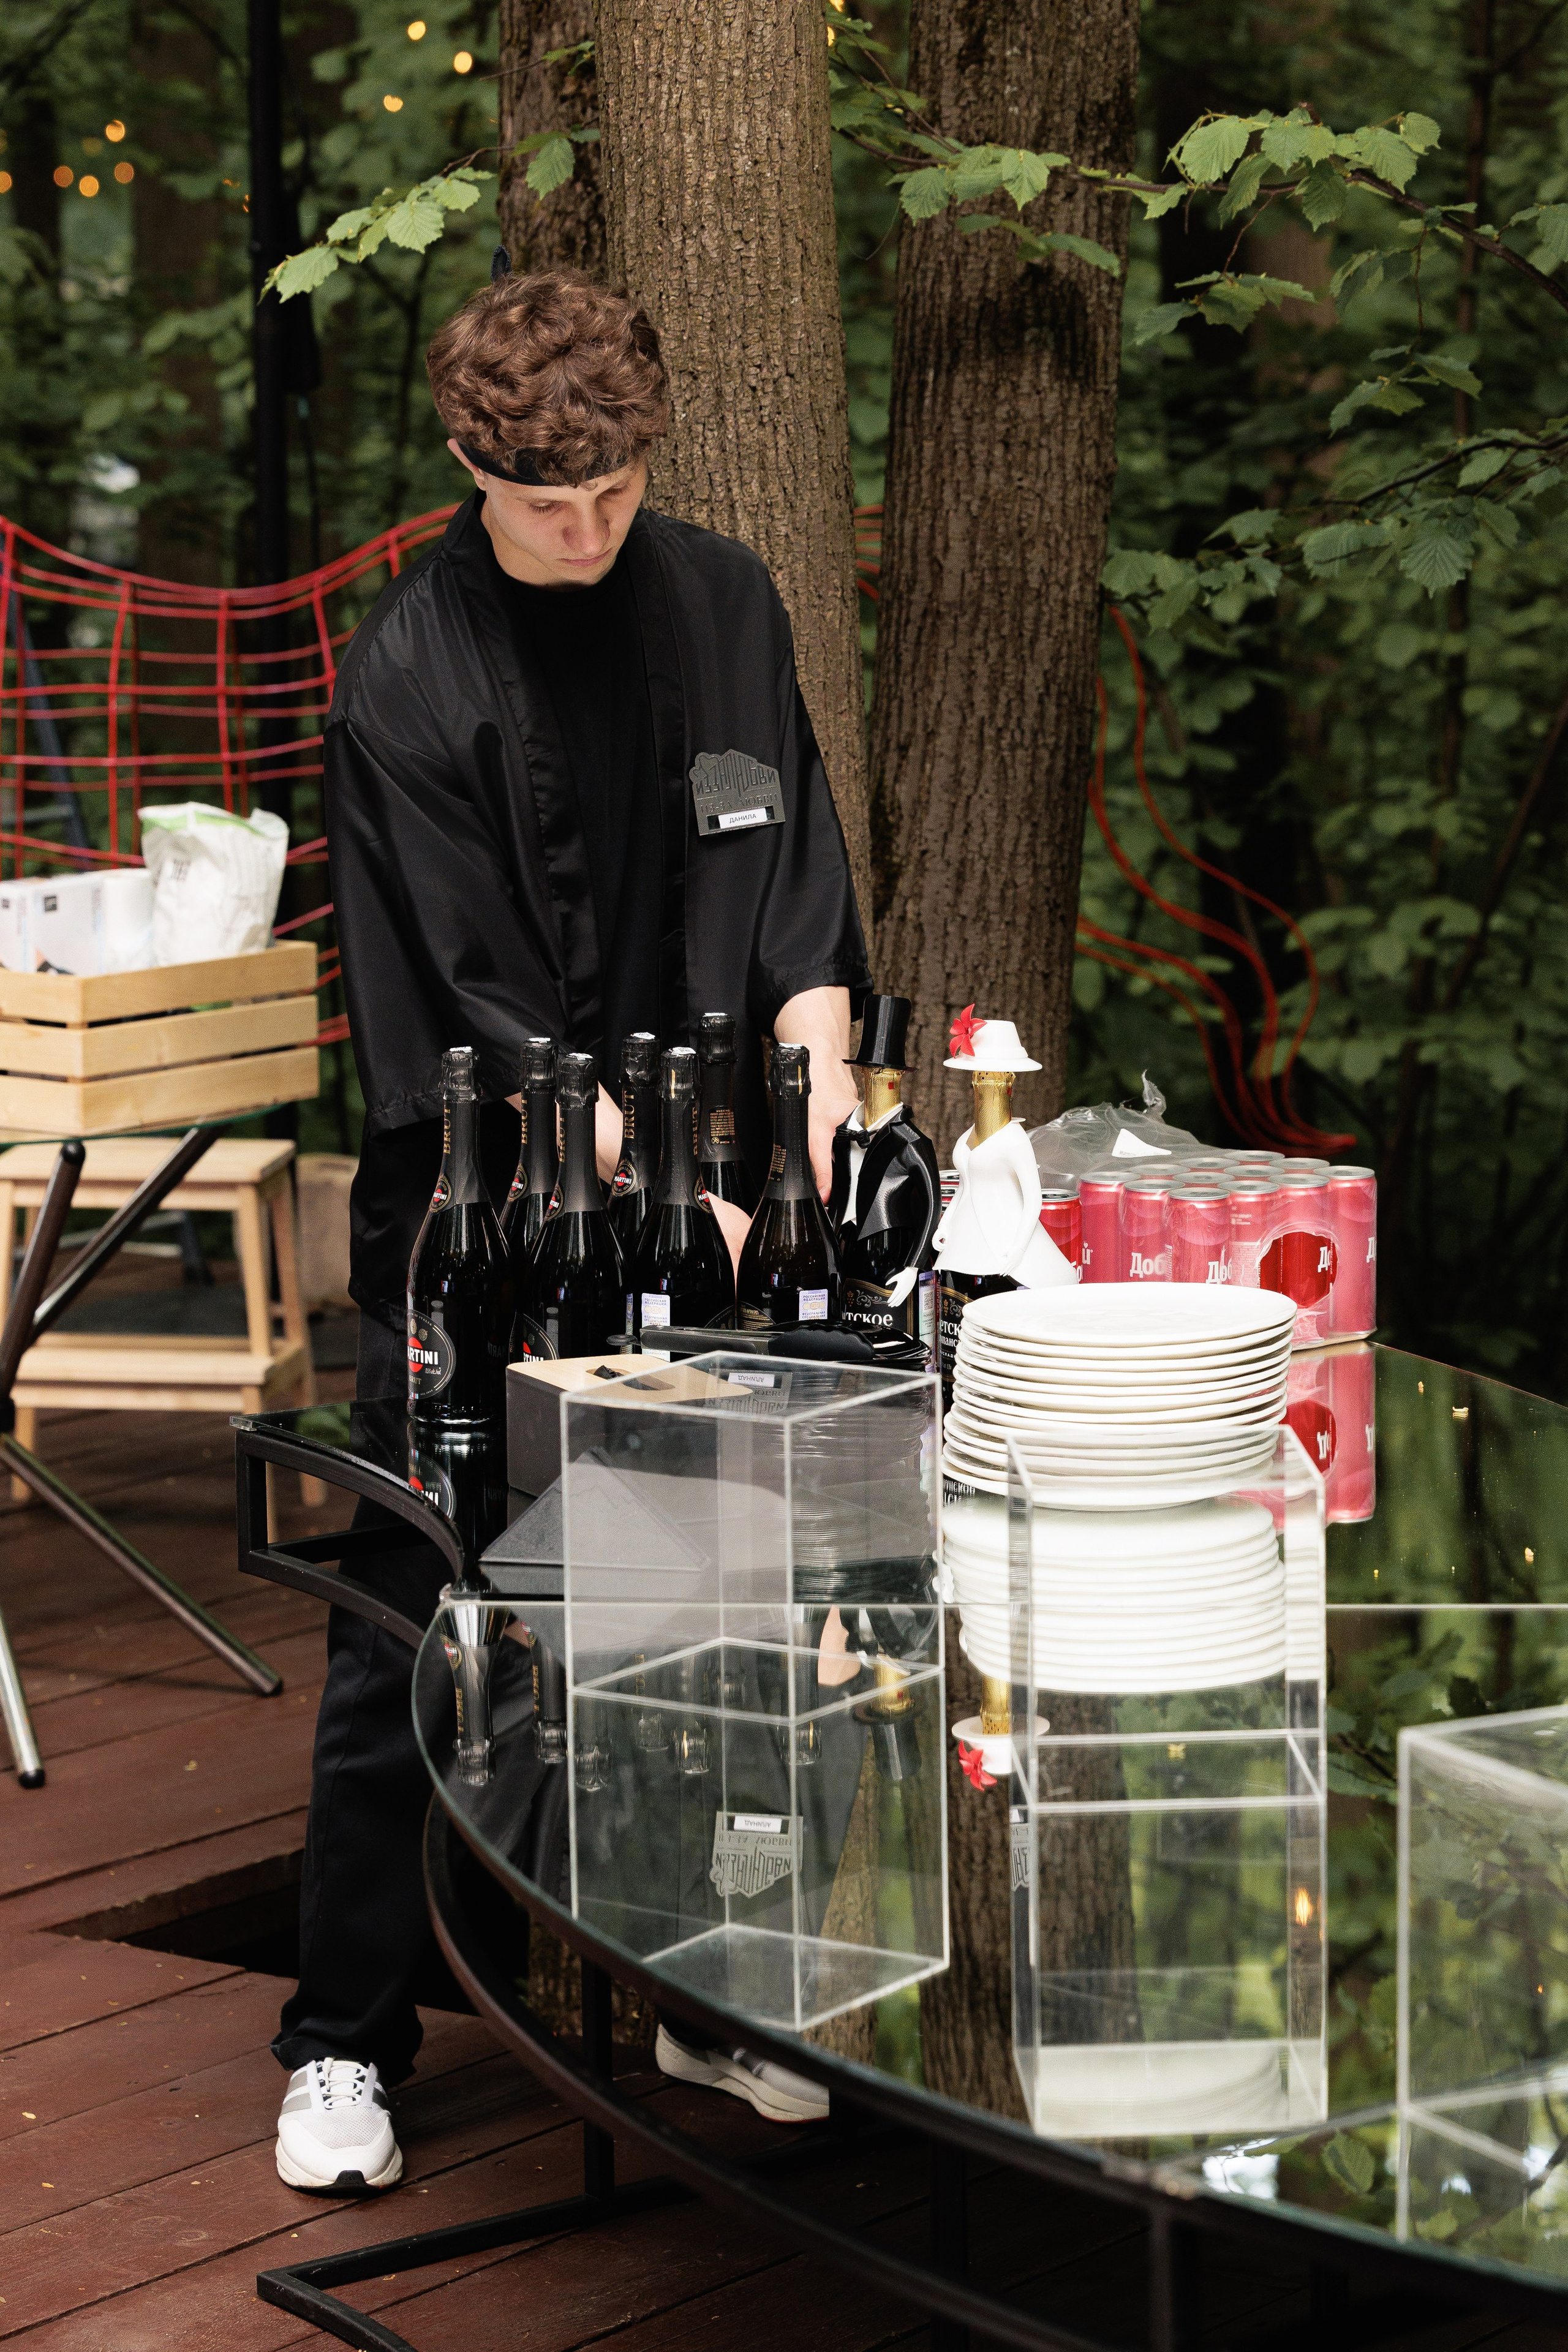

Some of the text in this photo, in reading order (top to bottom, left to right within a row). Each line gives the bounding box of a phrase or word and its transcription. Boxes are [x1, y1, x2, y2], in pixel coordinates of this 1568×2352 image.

[729, 813, 757, 824] ДАНИЛА
[624, 1090, 635, 1139] BRUT
[614, 1175, 632, 1185] MARTINI
[1129, 1252, 1166, 1278] Доб
